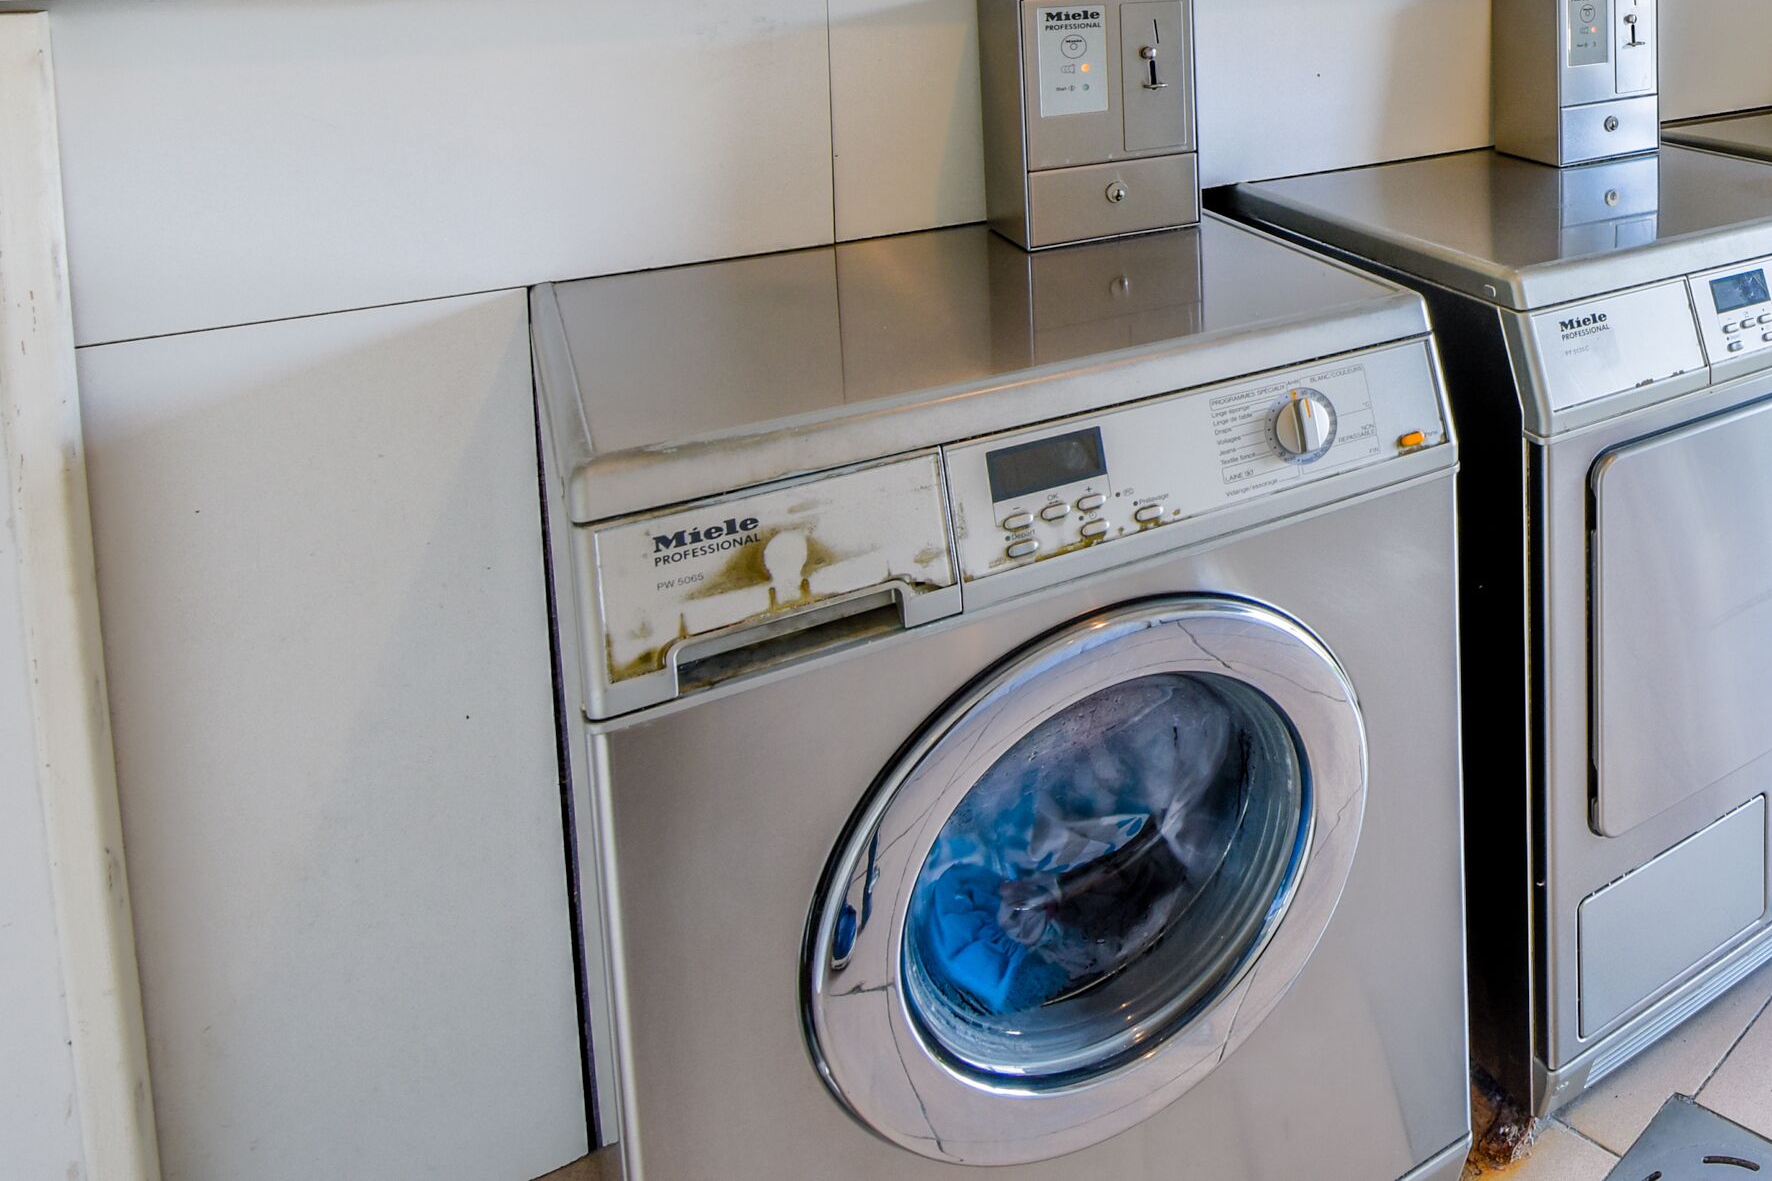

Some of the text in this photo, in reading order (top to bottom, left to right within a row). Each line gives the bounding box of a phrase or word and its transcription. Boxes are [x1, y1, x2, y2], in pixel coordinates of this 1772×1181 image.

[1045, 10, 1100, 22] Miele
[1045, 22, 1101, 31] PROFESSIONAL
[1558, 313, 1607, 332] Miele
[1561, 323, 1610, 341] PROFESSIONAL
[1211, 391, 1256, 407] PROGRAMMES
[1046, 493, 1059, 501] OK
[652, 517, 759, 553] Miele
[654, 533, 761, 567] PROFESSIONAL
[656, 572, 705, 591] PW 5065
